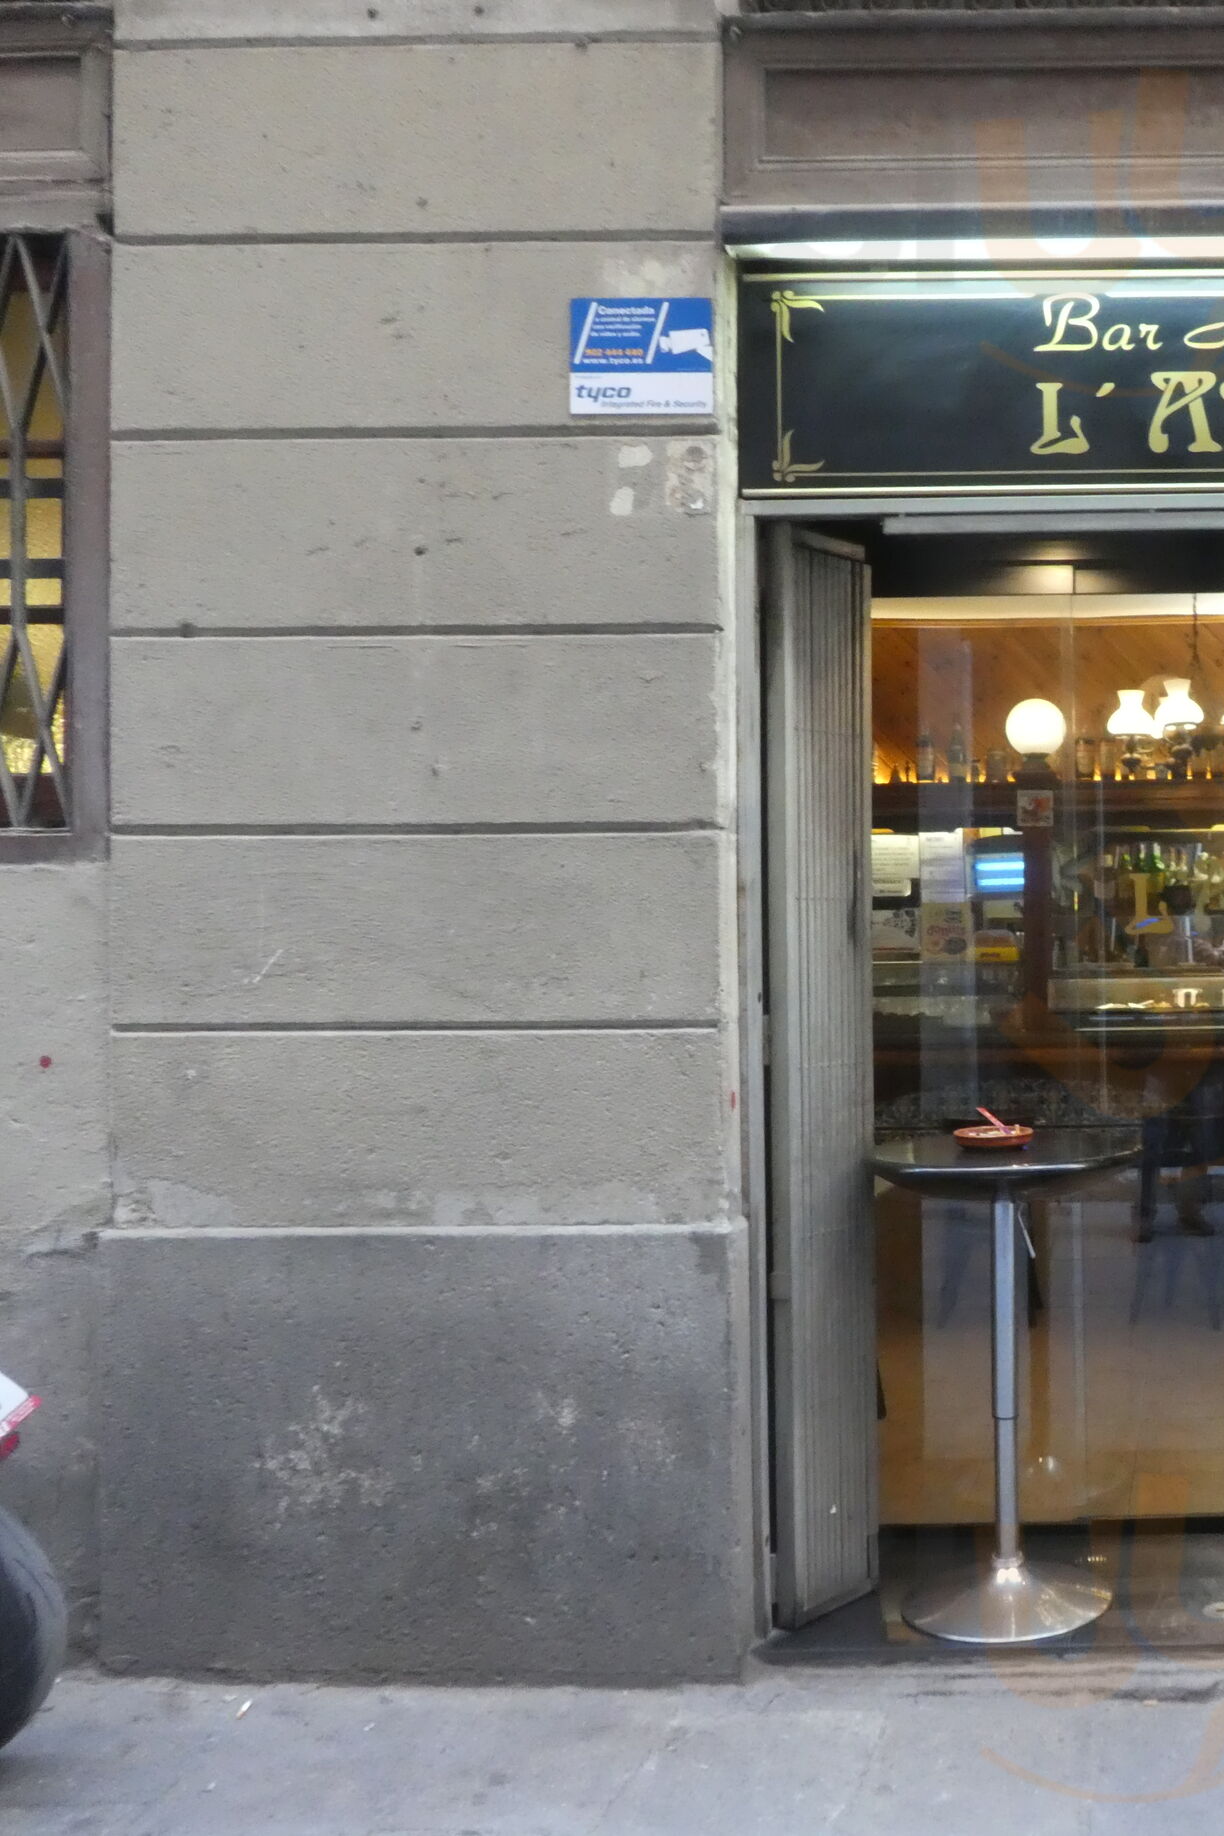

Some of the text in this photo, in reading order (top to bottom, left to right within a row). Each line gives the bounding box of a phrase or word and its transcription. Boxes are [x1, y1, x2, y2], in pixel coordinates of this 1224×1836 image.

[1034, 292, 1163, 352] Bar
[582, 357, 644, 365] www.tyco.es
[576, 385, 632, 403] tyco
[601, 400, 644, 409] Integrated
[645, 400, 661, 408] Fire
[673, 400, 707, 409] Security
